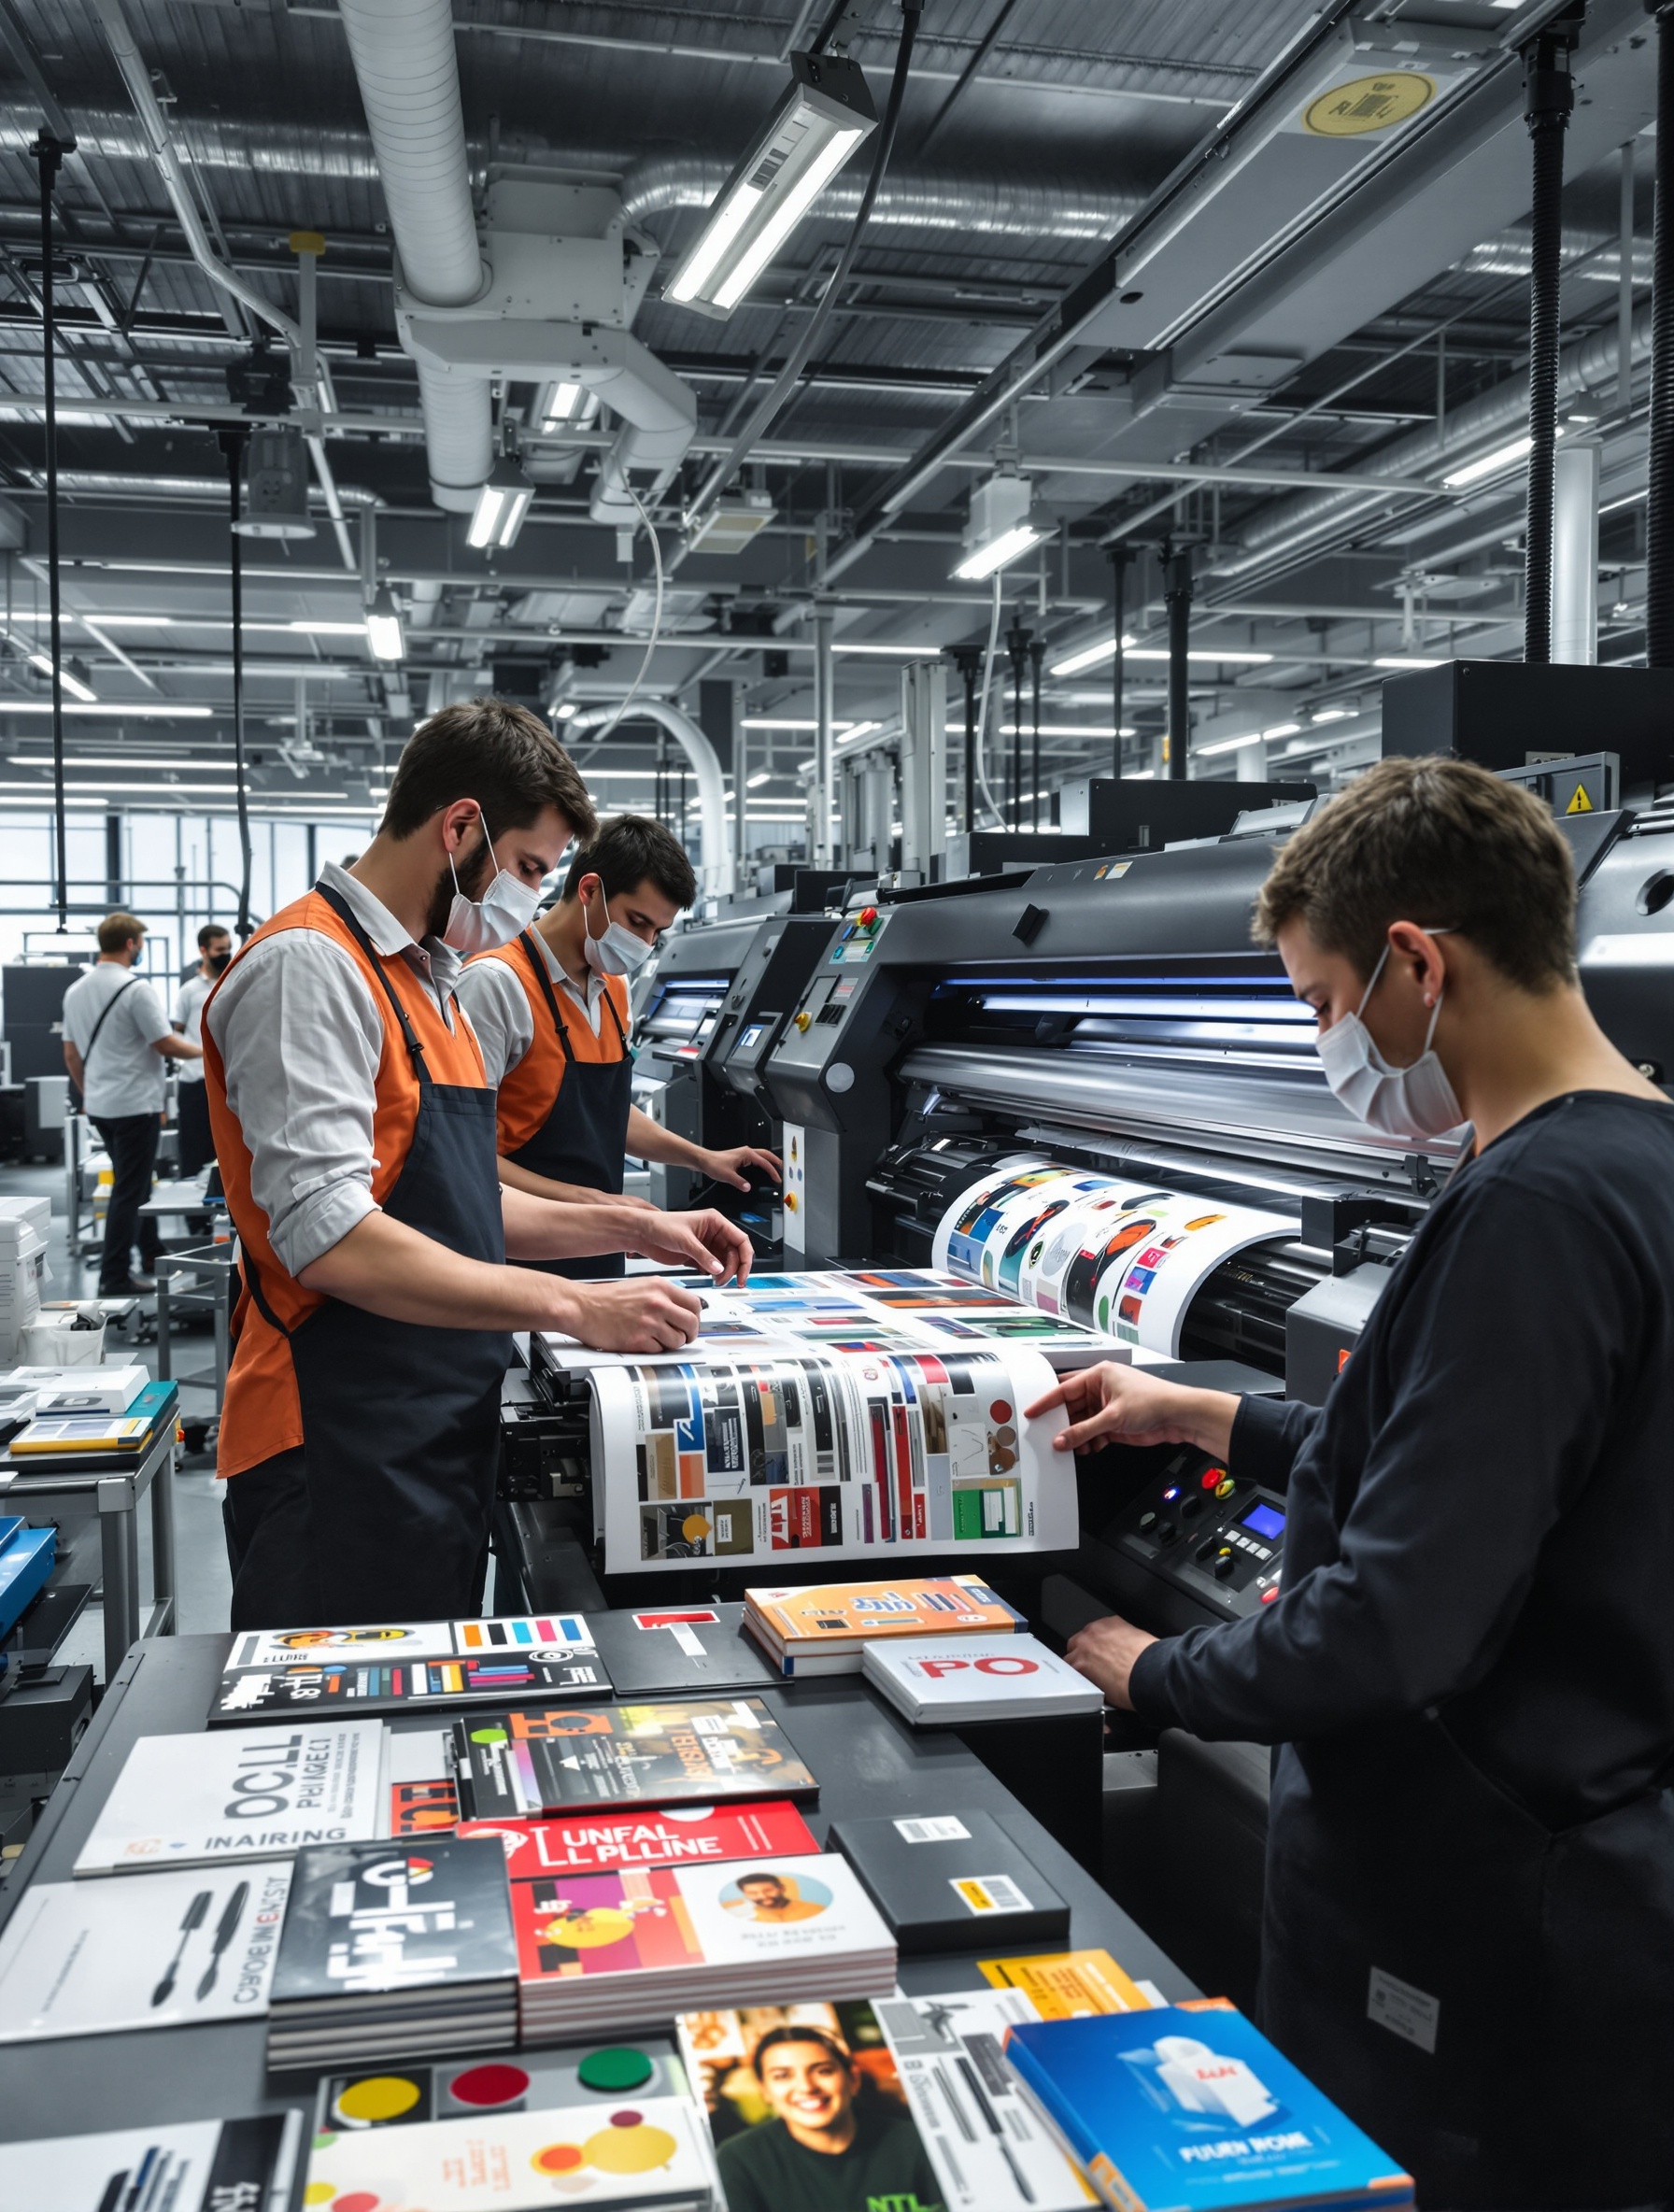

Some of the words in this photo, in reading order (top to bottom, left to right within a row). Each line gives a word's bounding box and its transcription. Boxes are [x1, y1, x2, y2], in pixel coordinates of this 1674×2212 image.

[918, 1656, 1040, 1679] PO
[204, 1827, 348, 1850] INAIRING
[562, 1824, 680, 1847] UNFAL
[596, 1836, 723, 1863] PLLINE
